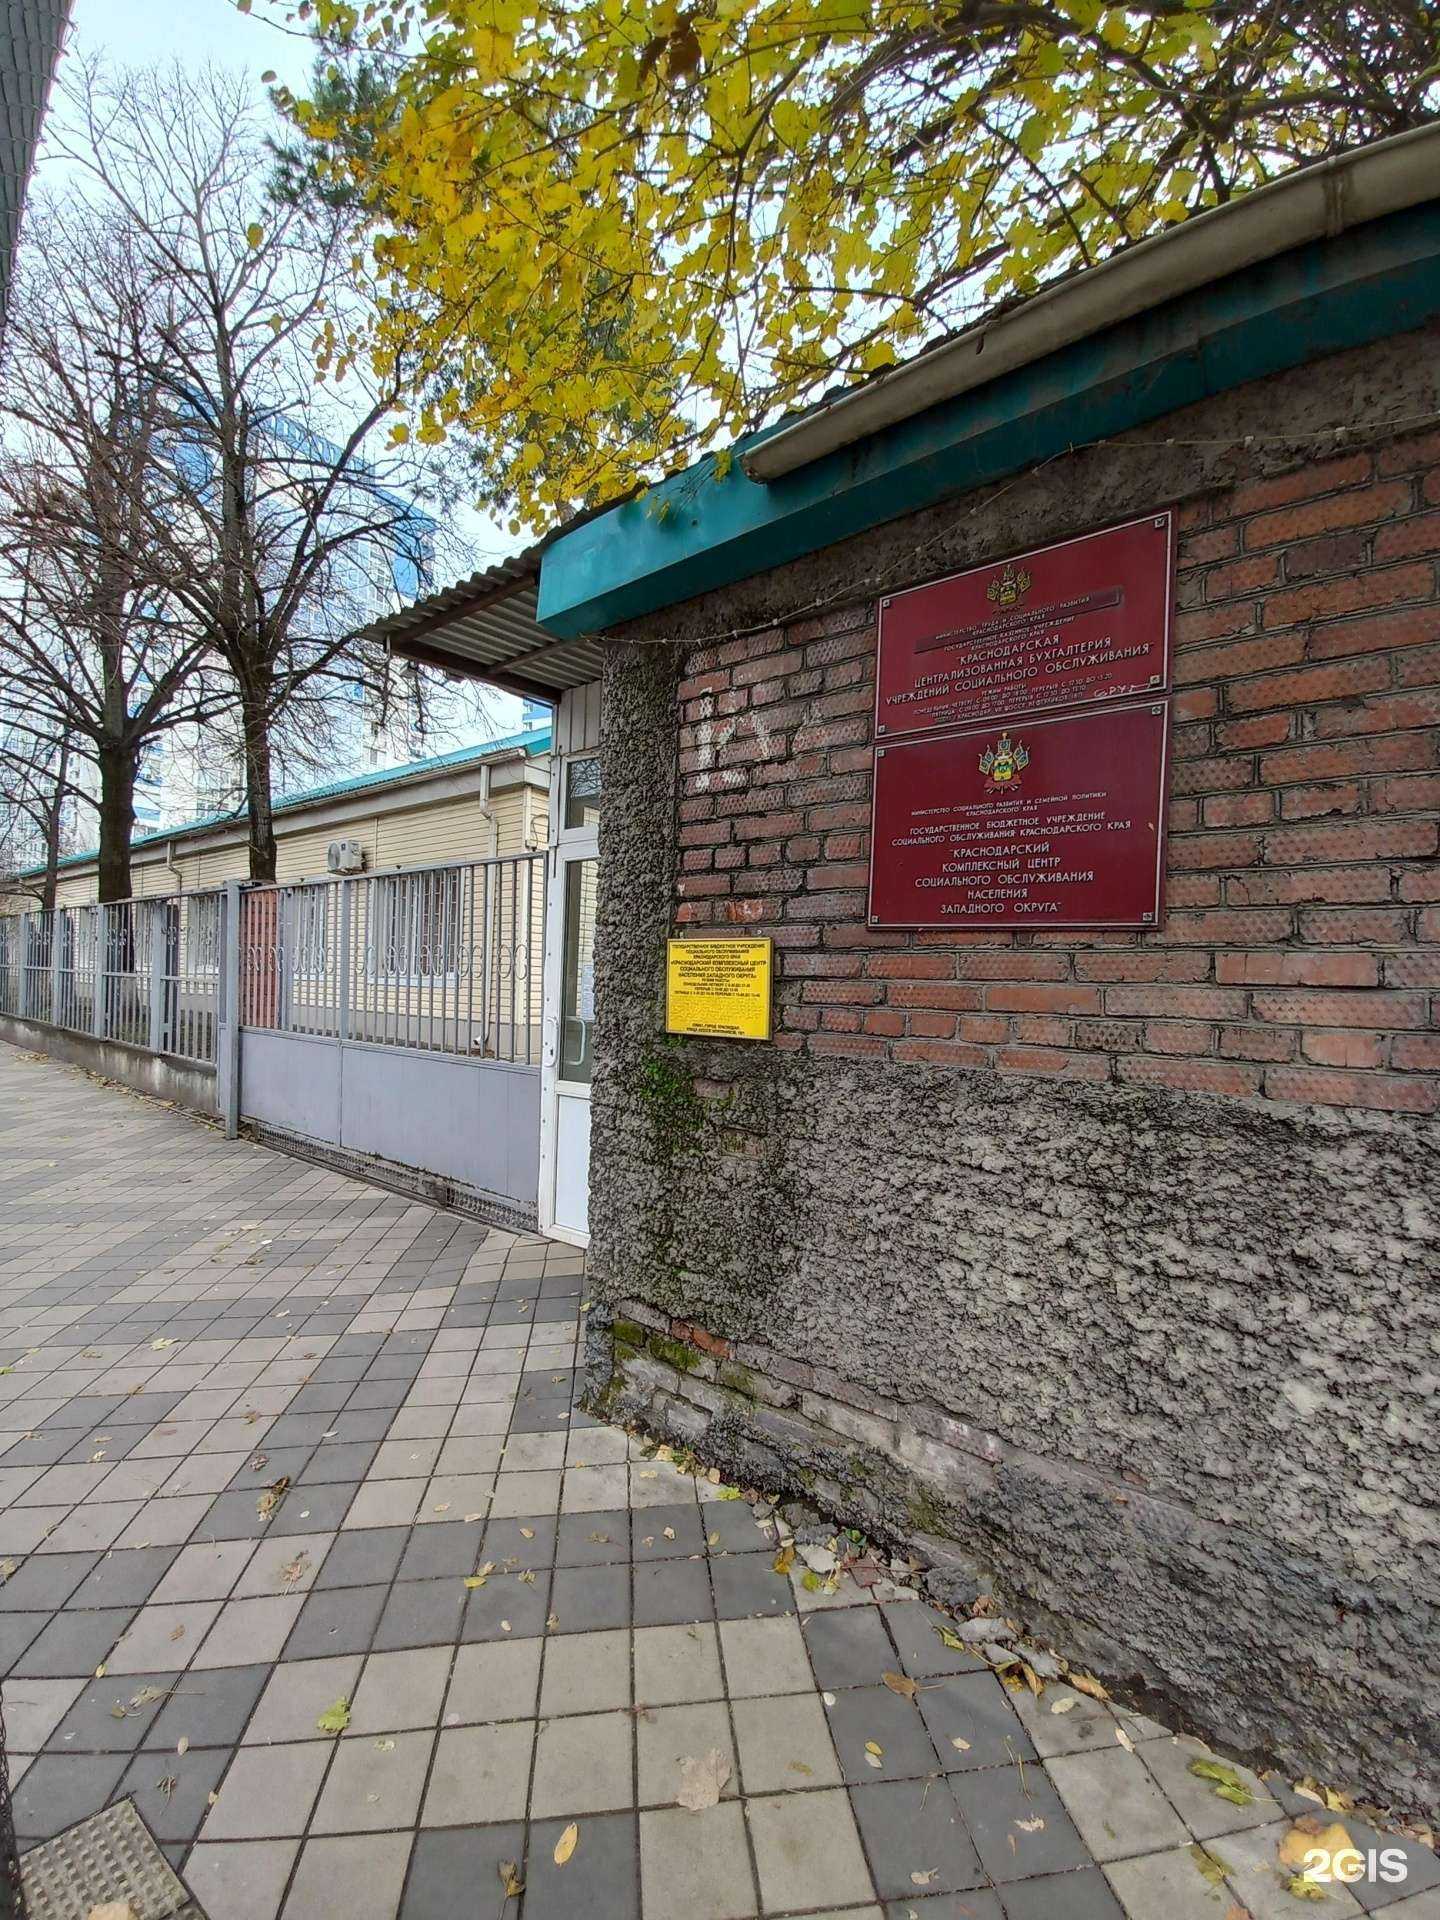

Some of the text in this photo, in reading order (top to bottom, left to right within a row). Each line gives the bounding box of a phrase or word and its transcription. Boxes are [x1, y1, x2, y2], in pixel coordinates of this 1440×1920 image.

[914, 637, 1111, 688] ЦЕНТРАЛИЗОВАННАЯ БУХГАЛТЕРИЯ
[886, 685, 949, 705] УЧРЕЖДЕНИЙ
[954, 667, 1038, 692] СОЦИАЛЬНОГО
[953, 803, 994, 812] СОЦИАЛЬНОГО
[966, 806, 1020, 816] КРАСНОДАРСКОГО
[910, 812, 1106, 835] ГОСУДАРСТВЕННОЕ БЮДЖЕТНОЕ УЧРЕЖДЕНИЕ
[892, 820, 1131, 846] СОЦИАЛЬНОГО ОБСЛУЖИВАНИЯ КРАСНОДАРСКОГО КРАЯ
[942, 857, 1061, 872] КОМПЛЕКСНЫЙ ЦЕНТР
[914, 871, 1094, 888] СОЦИАЛЬНОГО ОБСЛУЖИВАНИЯ
[968, 888, 1028, 900] НАСЕЛЕНИЯ
[940, 903, 1004, 914] ЗАПАДНОГО
